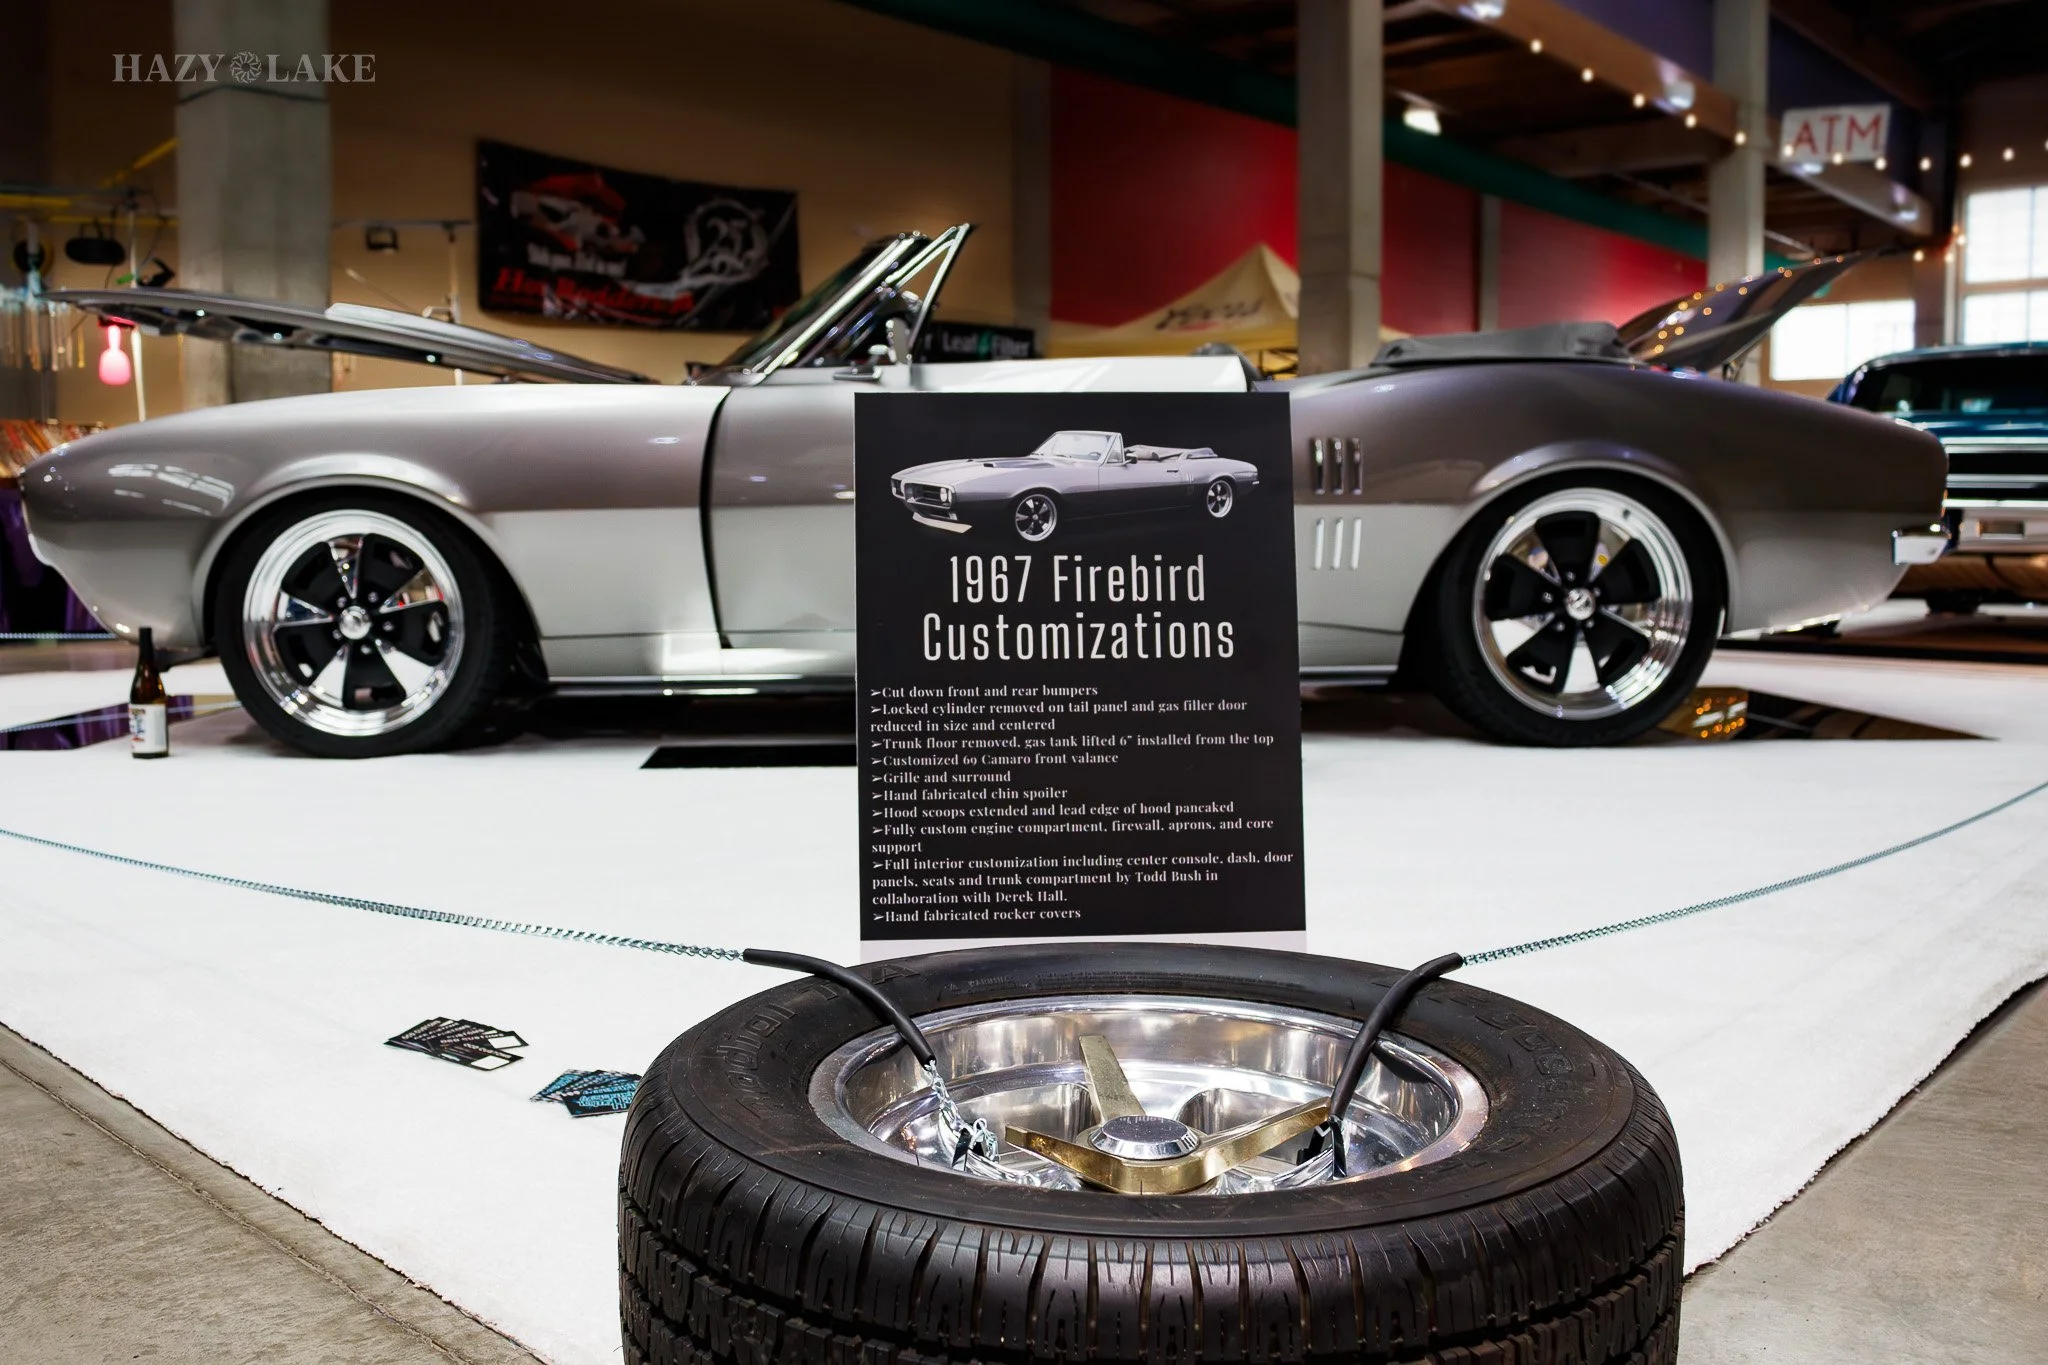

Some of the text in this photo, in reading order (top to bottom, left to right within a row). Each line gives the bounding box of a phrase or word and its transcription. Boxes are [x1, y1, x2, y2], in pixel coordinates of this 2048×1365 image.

[1792, 112, 1883, 156] ATM
[942, 331, 979, 353] Leaf
[991, 333, 1030, 357] Filter
[950, 553, 1206, 603] 1967 Firebird
[923, 610, 1235, 662] Customizations
[882, 684, 1098, 698] Cut down front and rear bumpers
[883, 699, 1248, 716] Locked cylinder removed on tail panel and gas filler door
[870, 718, 1055, 732] reduced in size and centered
[882, 737, 922, 749] Trunk
[927, 737, 958, 749] floor
[1025, 739, 1046, 749] gas
[1050, 735, 1078, 747] tank
[1082, 734, 1116, 747] lifted
[1137, 733, 1191, 746] installed
[1196, 733, 1225, 745] from
[1230, 733, 1250, 744] the
[1254, 734, 1274, 746] top
[883, 752, 1118, 766] Customized 69 Camaro front valance
[883, 770, 1011, 783] Grille and surround
[884, 786, 1068, 801] Hand fabricated chin spoiler
[884, 801, 1234, 818] Hood scoops extended and lead edge of hood pancaked
[884, 823, 916, 837] Fully
[920, 824, 967, 835] custom
[971, 822, 1014, 835] engine
[1220, 817, 1242, 829] and
[1246, 820, 1274, 829] core
[872, 842, 922, 854] support
[885, 858, 909, 870] Full
[914, 857, 964, 869] interior
[968, 856, 1058, 869] customization
[1063, 854, 1123, 867] including
[1126, 855, 1168, 866] center
[1264, 852, 1294, 863] door
[922, 876, 955, 887] seats
[959, 874, 982, 886] and
[987, 873, 1022, 885] trunk
[1026, 873, 1111, 886] compartment
[1116, 871, 1129, 884] by
[1135, 870, 1166, 883] Todd
[1172, 870, 1202, 882] Bush
[1206, 870, 1218, 881] in
[872, 893, 958, 905] collaboration
[962, 891, 991, 903] with
[996, 891, 1034, 903] Derek
[886, 908, 1081, 922] Hand fabricated rocker covers
